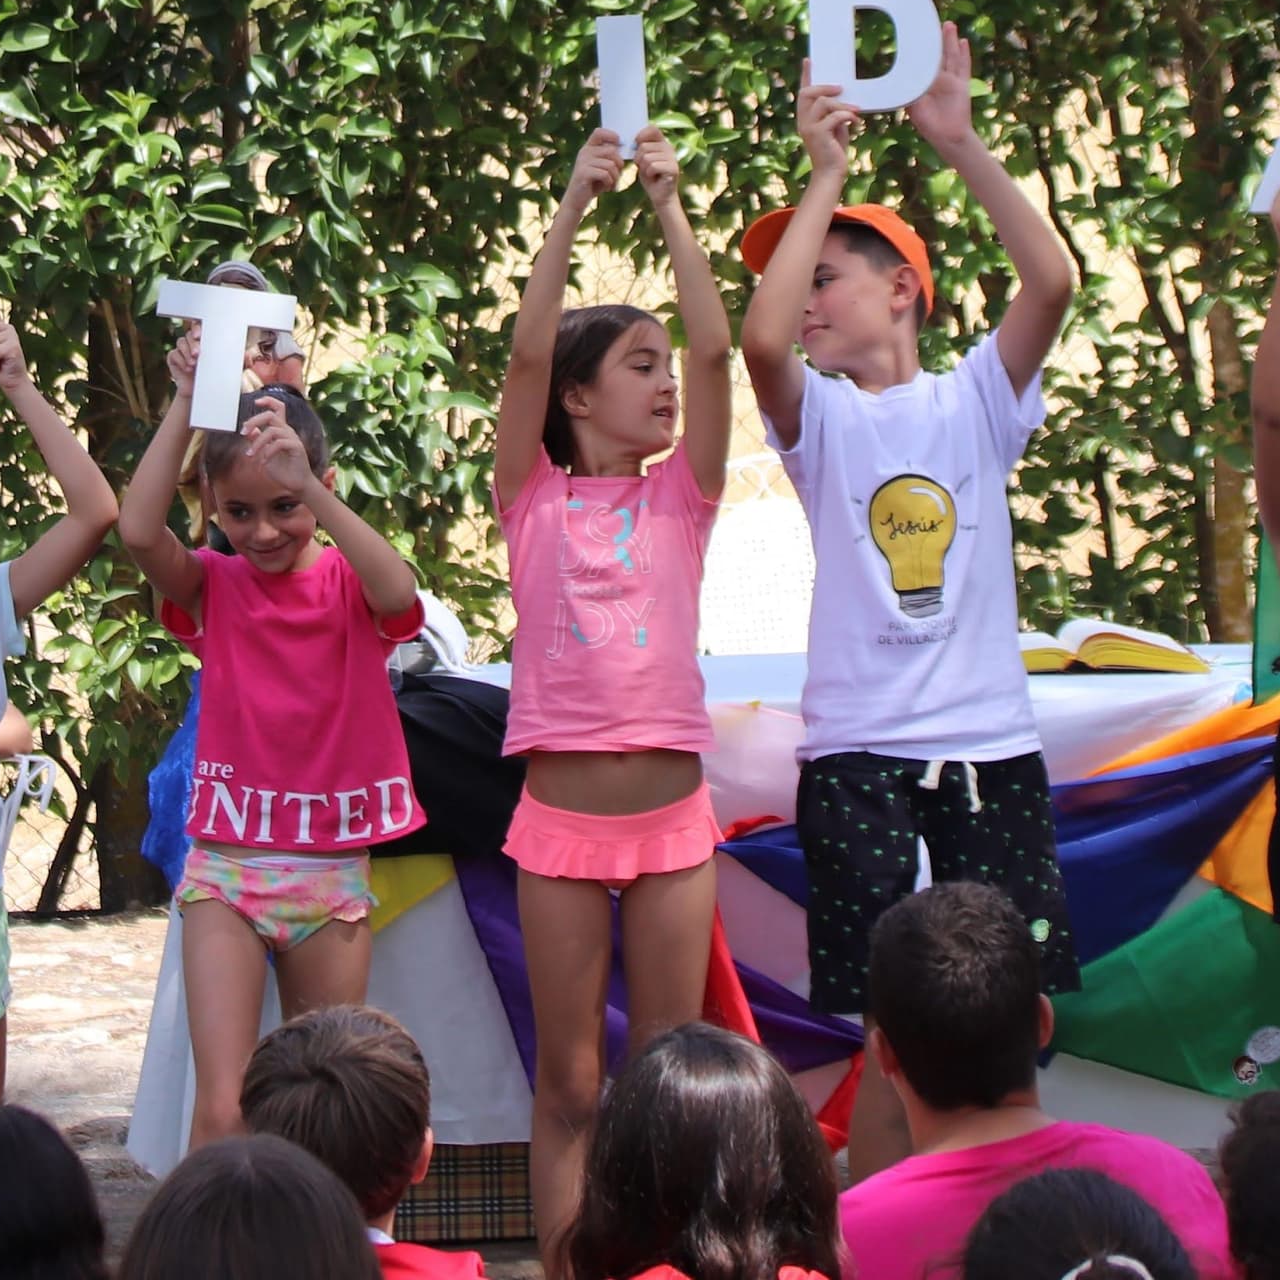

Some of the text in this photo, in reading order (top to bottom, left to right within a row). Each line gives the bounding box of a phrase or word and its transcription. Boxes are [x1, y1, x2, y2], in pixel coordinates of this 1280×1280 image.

[157, 279, 297, 432] T
[546, 598, 656, 660] JOY
[198, 760, 234, 779] are
